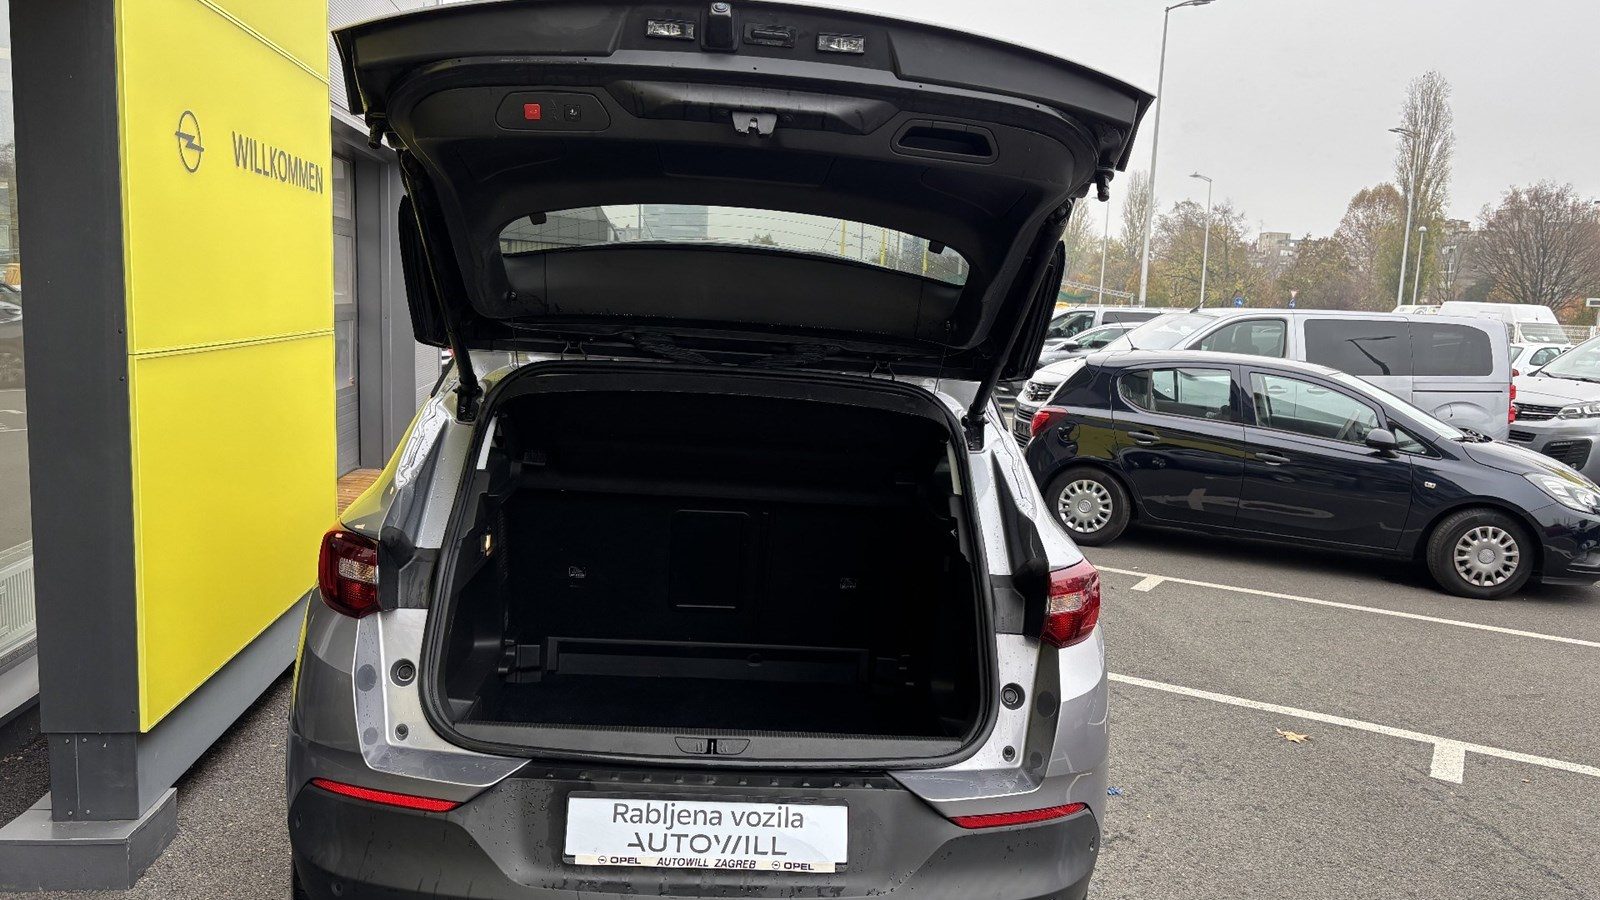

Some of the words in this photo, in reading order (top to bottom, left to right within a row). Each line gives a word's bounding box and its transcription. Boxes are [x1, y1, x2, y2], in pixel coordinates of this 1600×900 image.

[232, 130, 323, 194] WILLKOMMEN
[612, 802, 723, 831] Rabljena
[731, 805, 805, 829] vozila
[627, 832, 788, 856] AUTOWILL
[610, 856, 642, 866] OPEL
[656, 856, 709, 868] AUTOWILL
[713, 858, 757, 869] ZAGREB
[783, 861, 815, 871] OPEL
